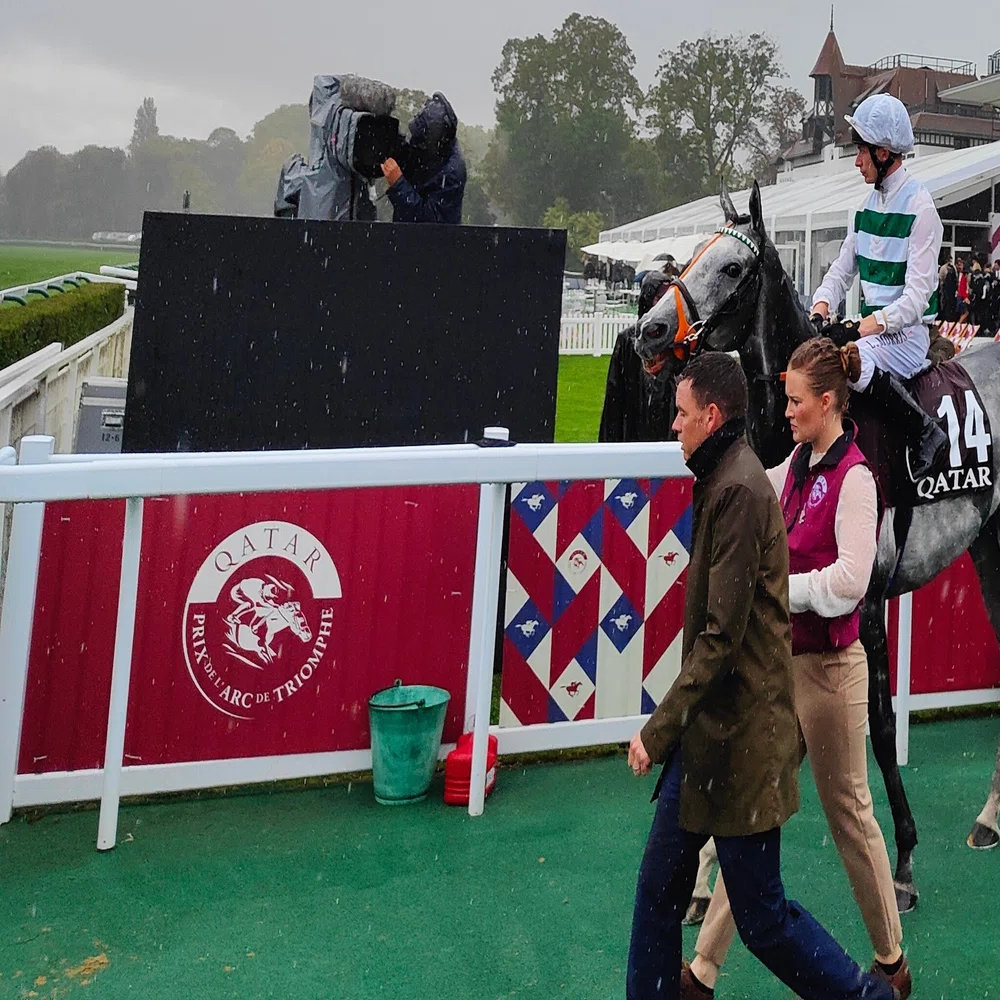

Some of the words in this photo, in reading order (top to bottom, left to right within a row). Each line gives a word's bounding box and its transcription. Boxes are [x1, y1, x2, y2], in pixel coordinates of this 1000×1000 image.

[937, 389, 992, 468] 14
[916, 466, 993, 500] QATAR
[214, 527, 321, 573] QATAR
[192, 612, 208, 665] PRIX
[203, 662, 218, 681] DE
[255, 692, 270, 704] DE
[272, 606, 334, 703] TRIOMPHE
